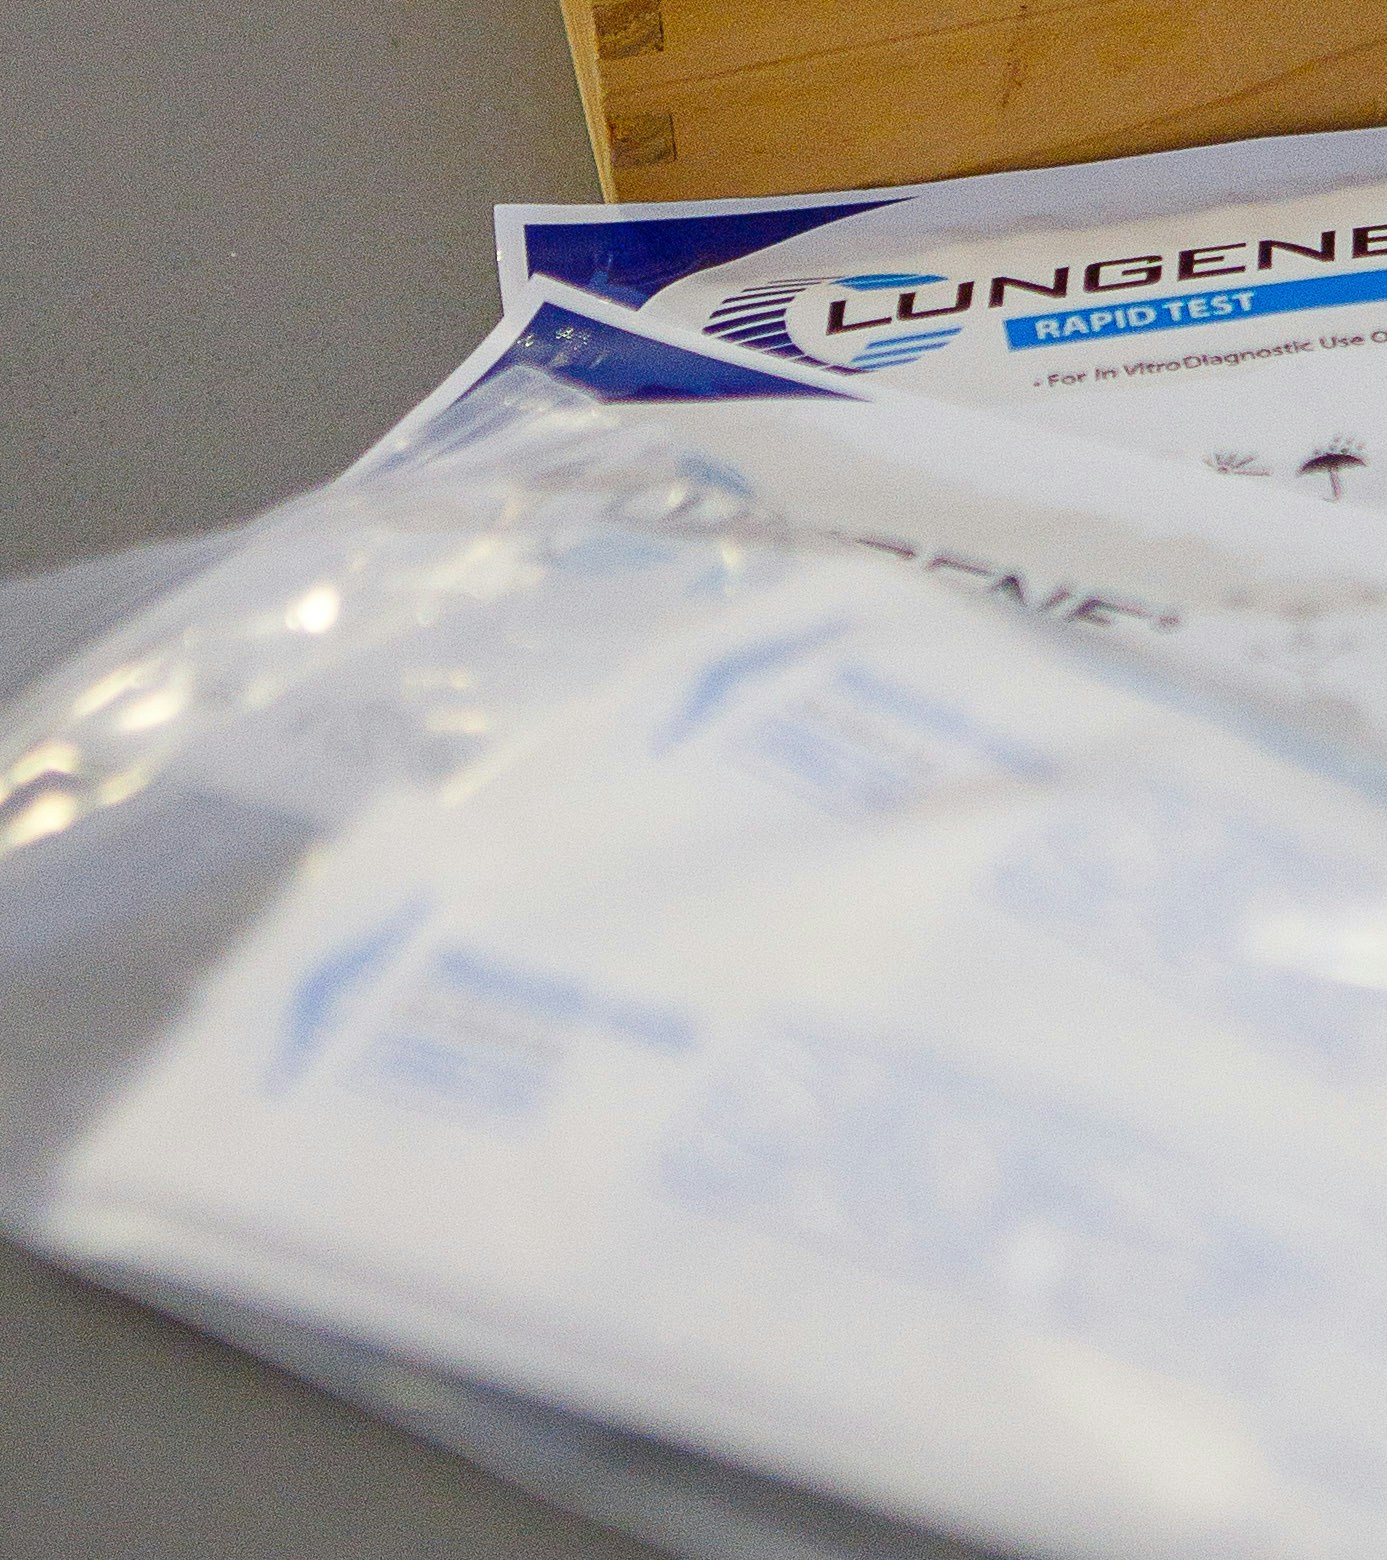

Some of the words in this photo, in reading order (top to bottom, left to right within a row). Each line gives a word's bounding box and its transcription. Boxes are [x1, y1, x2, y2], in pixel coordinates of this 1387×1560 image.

[1034, 304, 1158, 340] RAPID
[1161, 291, 1256, 322] TEST
[1047, 371, 1086, 388] For
[1319, 333, 1366, 350] Use
